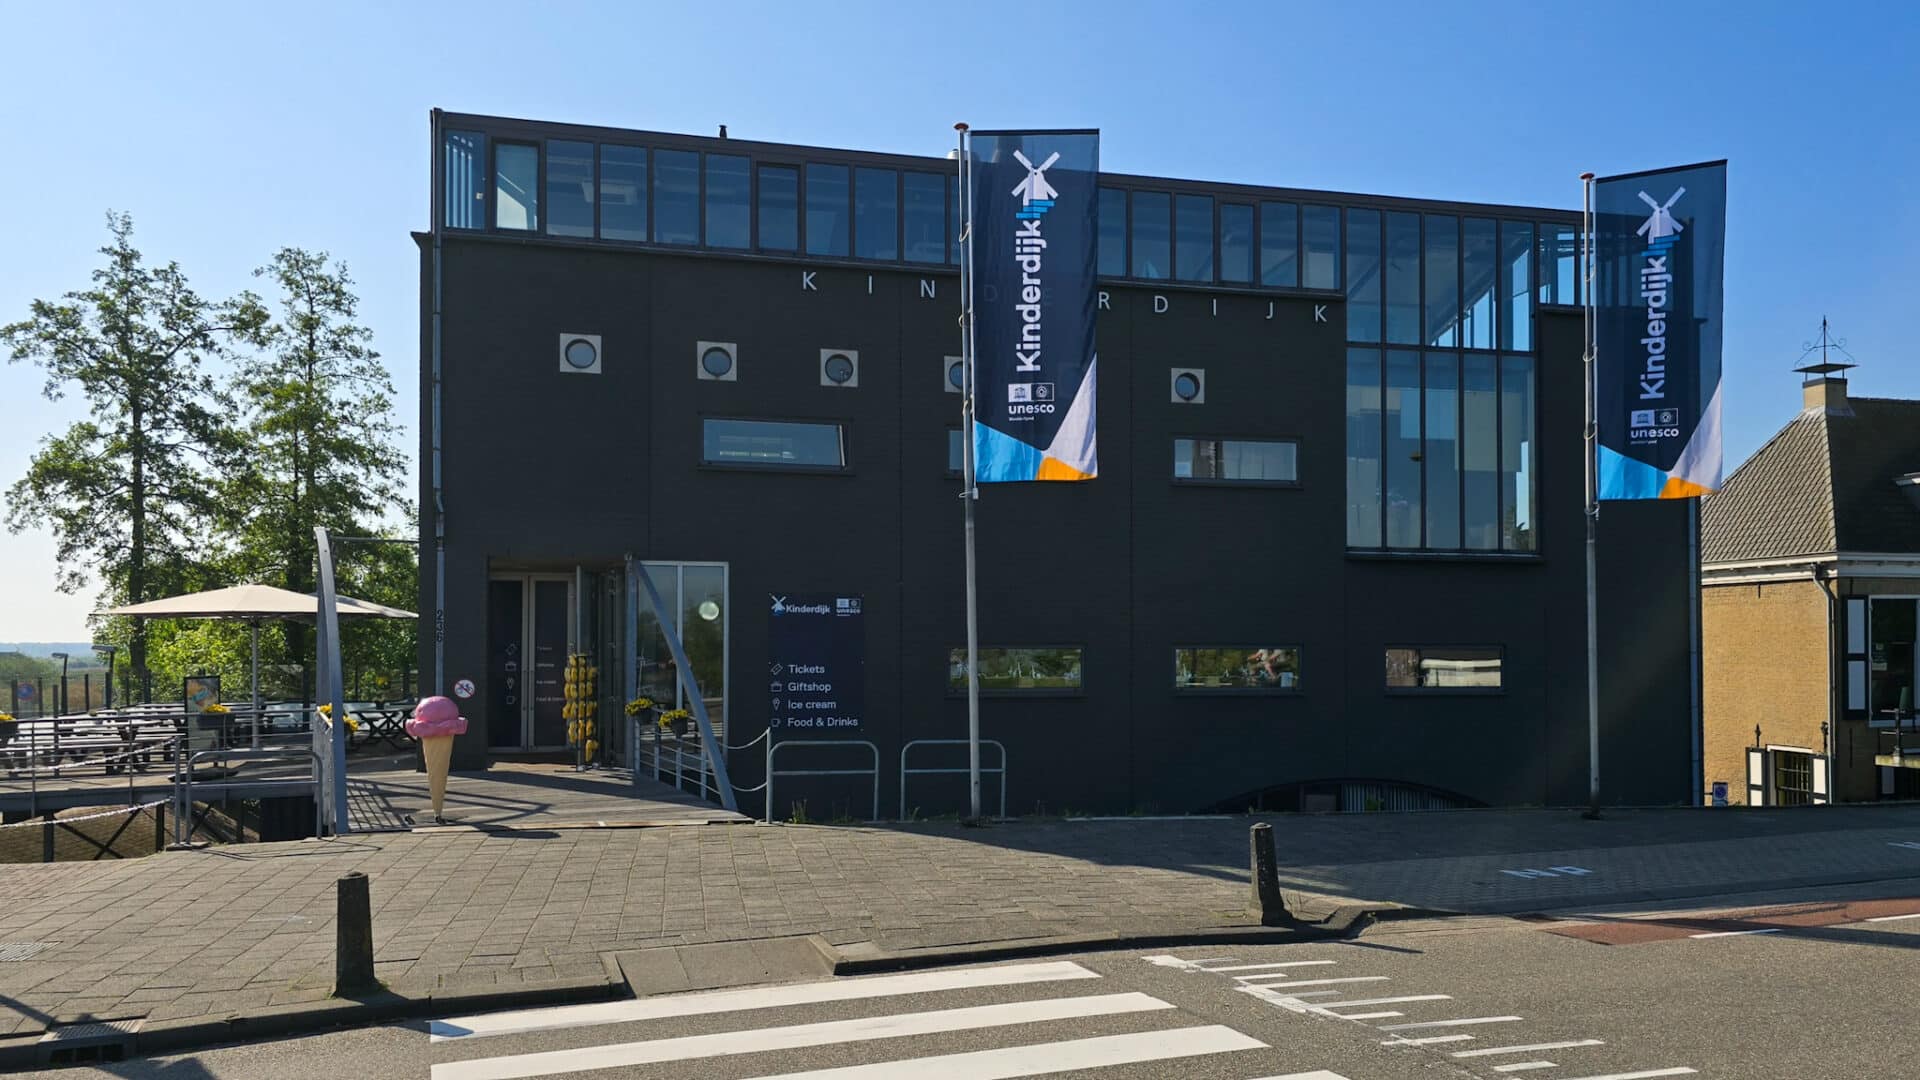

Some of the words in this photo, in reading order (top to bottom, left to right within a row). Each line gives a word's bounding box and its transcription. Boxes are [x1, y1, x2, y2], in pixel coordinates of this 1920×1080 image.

[1015, 220, 1047, 372] Kinderdijk
[1639, 255, 1673, 400] Kinderdijk
[1008, 404, 1055, 415] unesco
[1630, 428, 1680, 439] unesco
[786, 604, 831, 615] Kinderdijk
[788, 663, 826, 674] Tickets
[787, 682, 832, 693] Giftshop
[788, 700, 803, 709] Ice
[805, 701, 837, 709] cream
[788, 717, 813, 727] Food
[815, 717, 825, 727] &
[827, 717, 859, 727] Drinks
